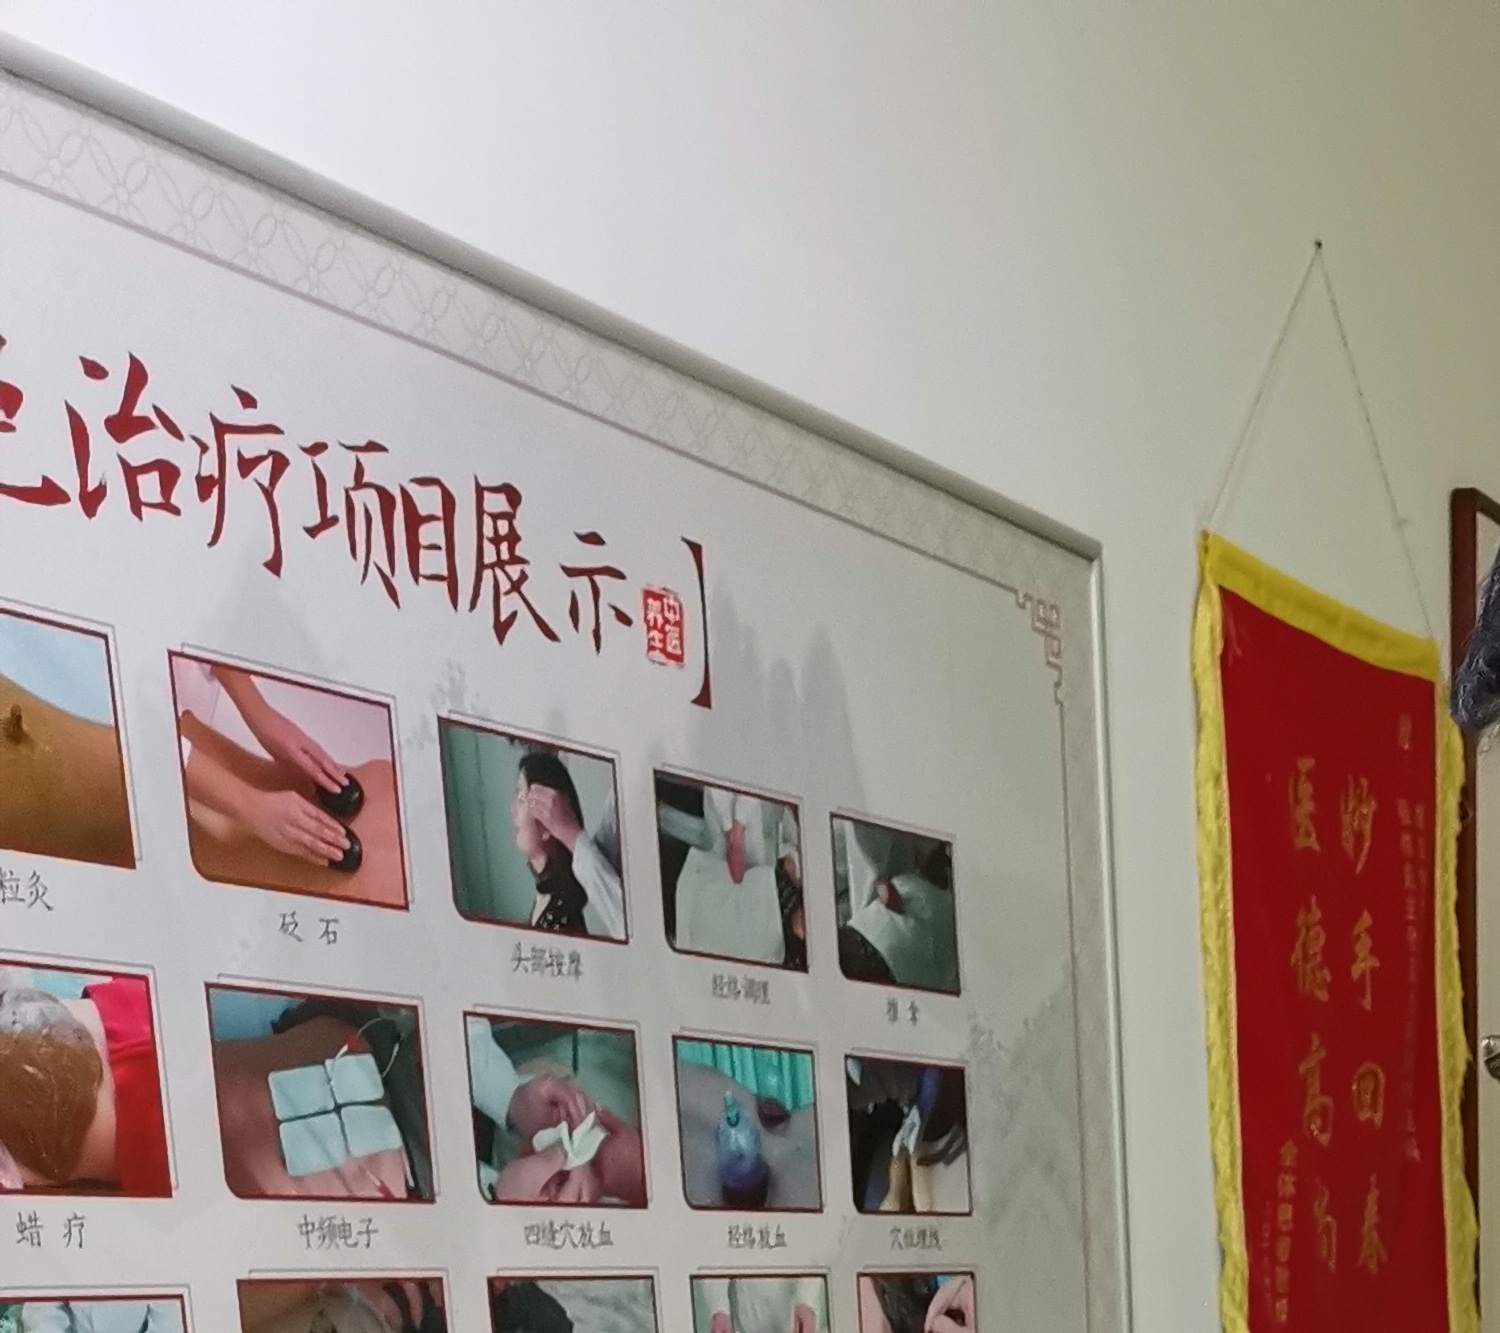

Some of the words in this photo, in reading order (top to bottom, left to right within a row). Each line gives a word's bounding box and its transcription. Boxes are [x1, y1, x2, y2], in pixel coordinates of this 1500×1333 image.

[15, 1209, 86, 1249] 蜡疗
[298, 1213, 379, 1250] 中频电子
